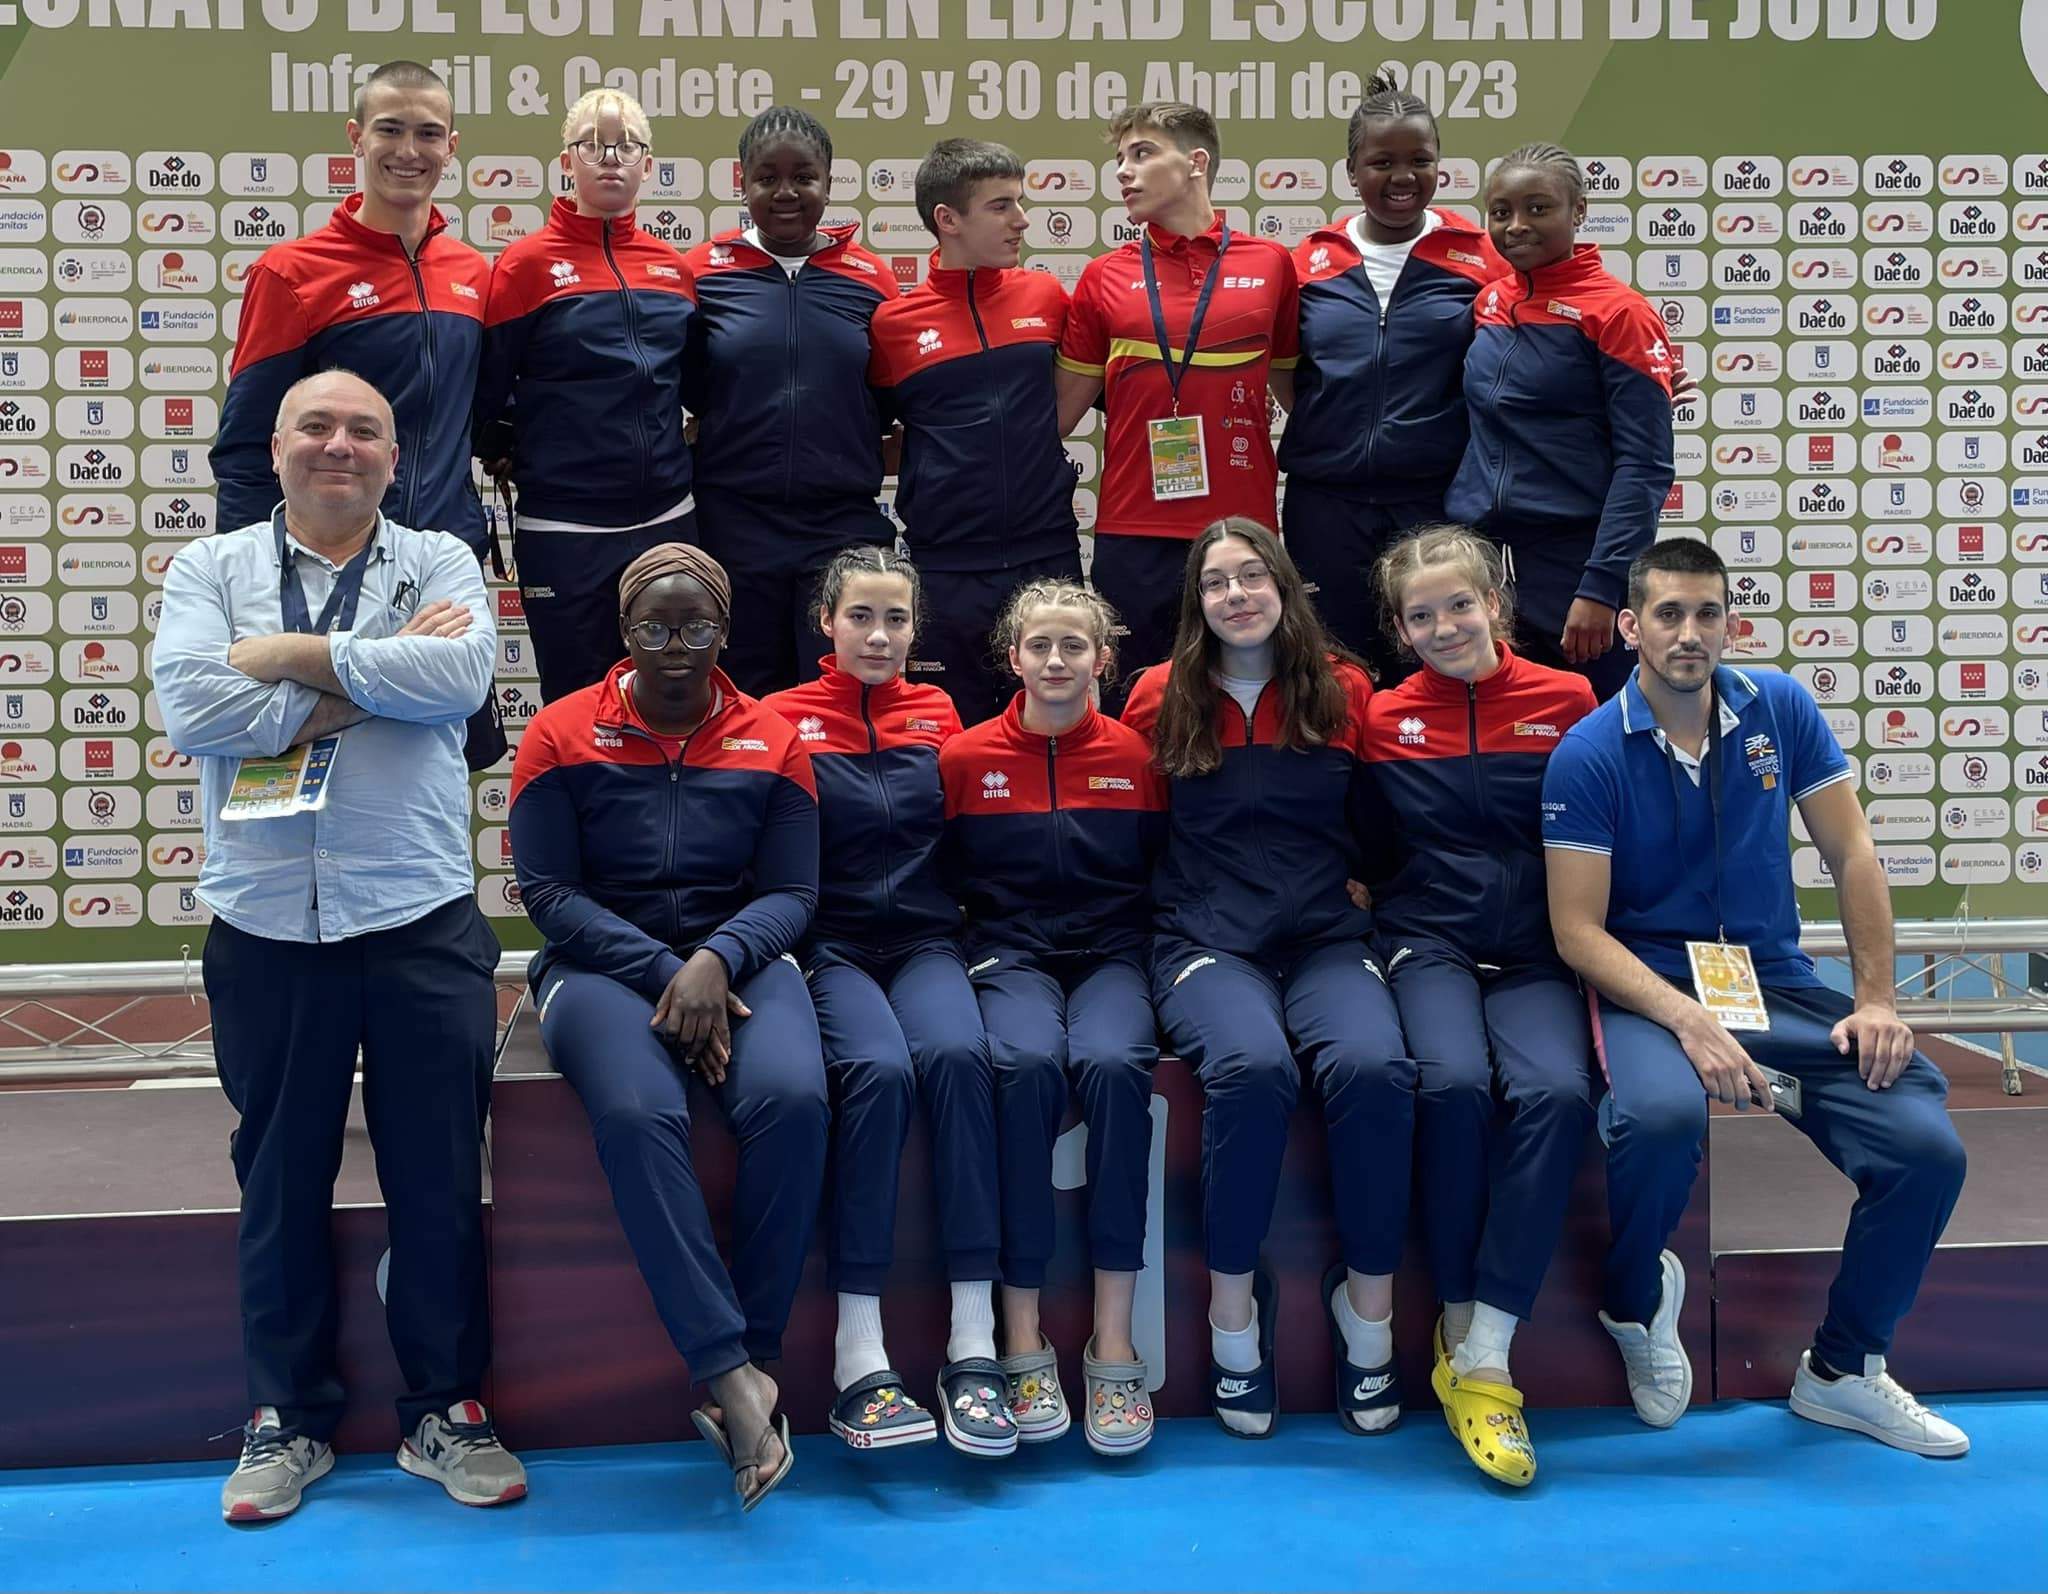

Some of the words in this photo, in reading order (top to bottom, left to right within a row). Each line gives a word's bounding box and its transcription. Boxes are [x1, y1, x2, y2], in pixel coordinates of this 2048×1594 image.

[507, 65, 549, 116] &
[835, 59, 907, 120] 29
[920, 70, 954, 125] y
[967, 59, 1041, 120] 30
[1056, 61, 1127, 120] de
[1291, 61, 1361, 119] de
[243, 185, 275, 193] MADRID
[0, 212, 44, 221] undación
[0, 221, 28, 230] anitas
[889, 223, 927, 232] IBERDRO
[91, 261, 126, 269] CESA
[1057, 265, 1082, 274] CES
[1, 266, 43, 274] ERDROLA
[554, 274, 581, 287] errea
[1223, 277, 1265, 289] ESP
[1658, 280, 1688, 288] MADRID
[353, 295, 380, 308] errea
[163, 311, 214, 320] Fundación
[1733, 307, 1780, 316] Fundación
[79, 316, 128, 324] IBERDROLA
[1733, 315, 1766, 324] Sanitas
[163, 320, 199, 329] Sanitas
[163, 365, 213, 374] IBERDROLA
[1807, 371, 1837, 379] MADRID
[1882, 398, 1929, 407] Fundación
[1882, 406, 1915, 415] Sanitas
[1744, 491, 1777, 500] CESA
[9, 506, 46, 514] CESA
[1883, 508, 1912, 516] MADRID
[1808, 542, 1853, 550] IBERDROLA
[82, 560, 131, 568] IBERDROLA
[1895, 581, 1928, 589] CESA
[1959, 631, 2004, 639] IBERDROLA
[1831, 720, 1855, 728] ESA
[595, 737, 623, 747] errea
[1399, 734, 1426, 744] errea
[1898, 764, 1931, 772] CESA
[983, 788, 1010, 798] errea
[1973, 809, 2006, 817] CESA
[1886, 816, 1931, 824] IBERDROLA
[2, 821, 33, 829] MADRID
[87, 847, 139, 857] Fundación
[87, 857, 123, 866] Sanitas
[1887, 857, 1933, 866] Fundación
[1960, 859, 2006, 867] IBERDROLA
[1886, 865, 1919, 875] Sanitas
[172, 914, 204, 922] MADRID
[1221, 1377, 1248, 1392] NIKE
[1361, 1374, 1390, 1390] NIKE
